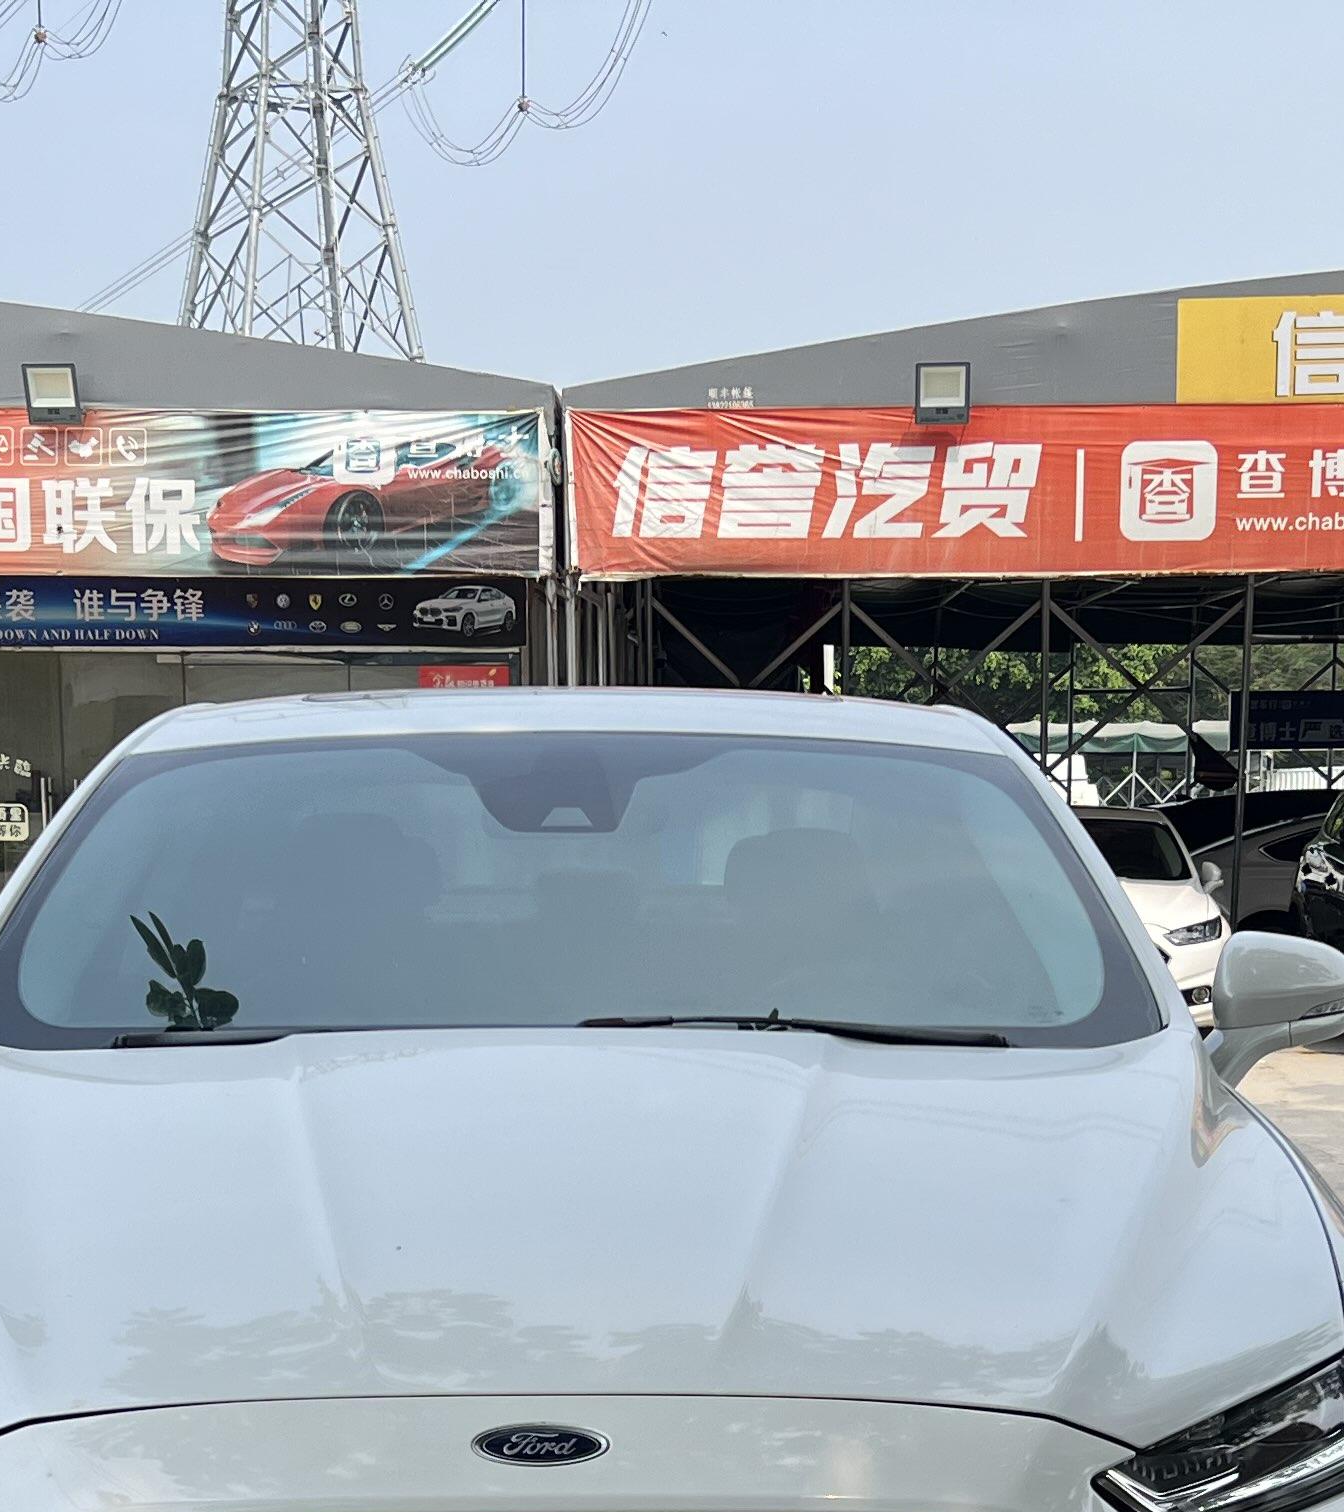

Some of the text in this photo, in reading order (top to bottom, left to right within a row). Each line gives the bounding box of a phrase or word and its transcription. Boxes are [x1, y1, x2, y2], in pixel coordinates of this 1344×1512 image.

[611, 441, 1043, 540] 信誉汽贸
[73, 587, 207, 623] 谁与争锋
[41, 628, 71, 641] AND
[74, 628, 113, 641] HALF
[115, 628, 160, 641] DOWN
[503, 1432, 577, 1456] Ford
